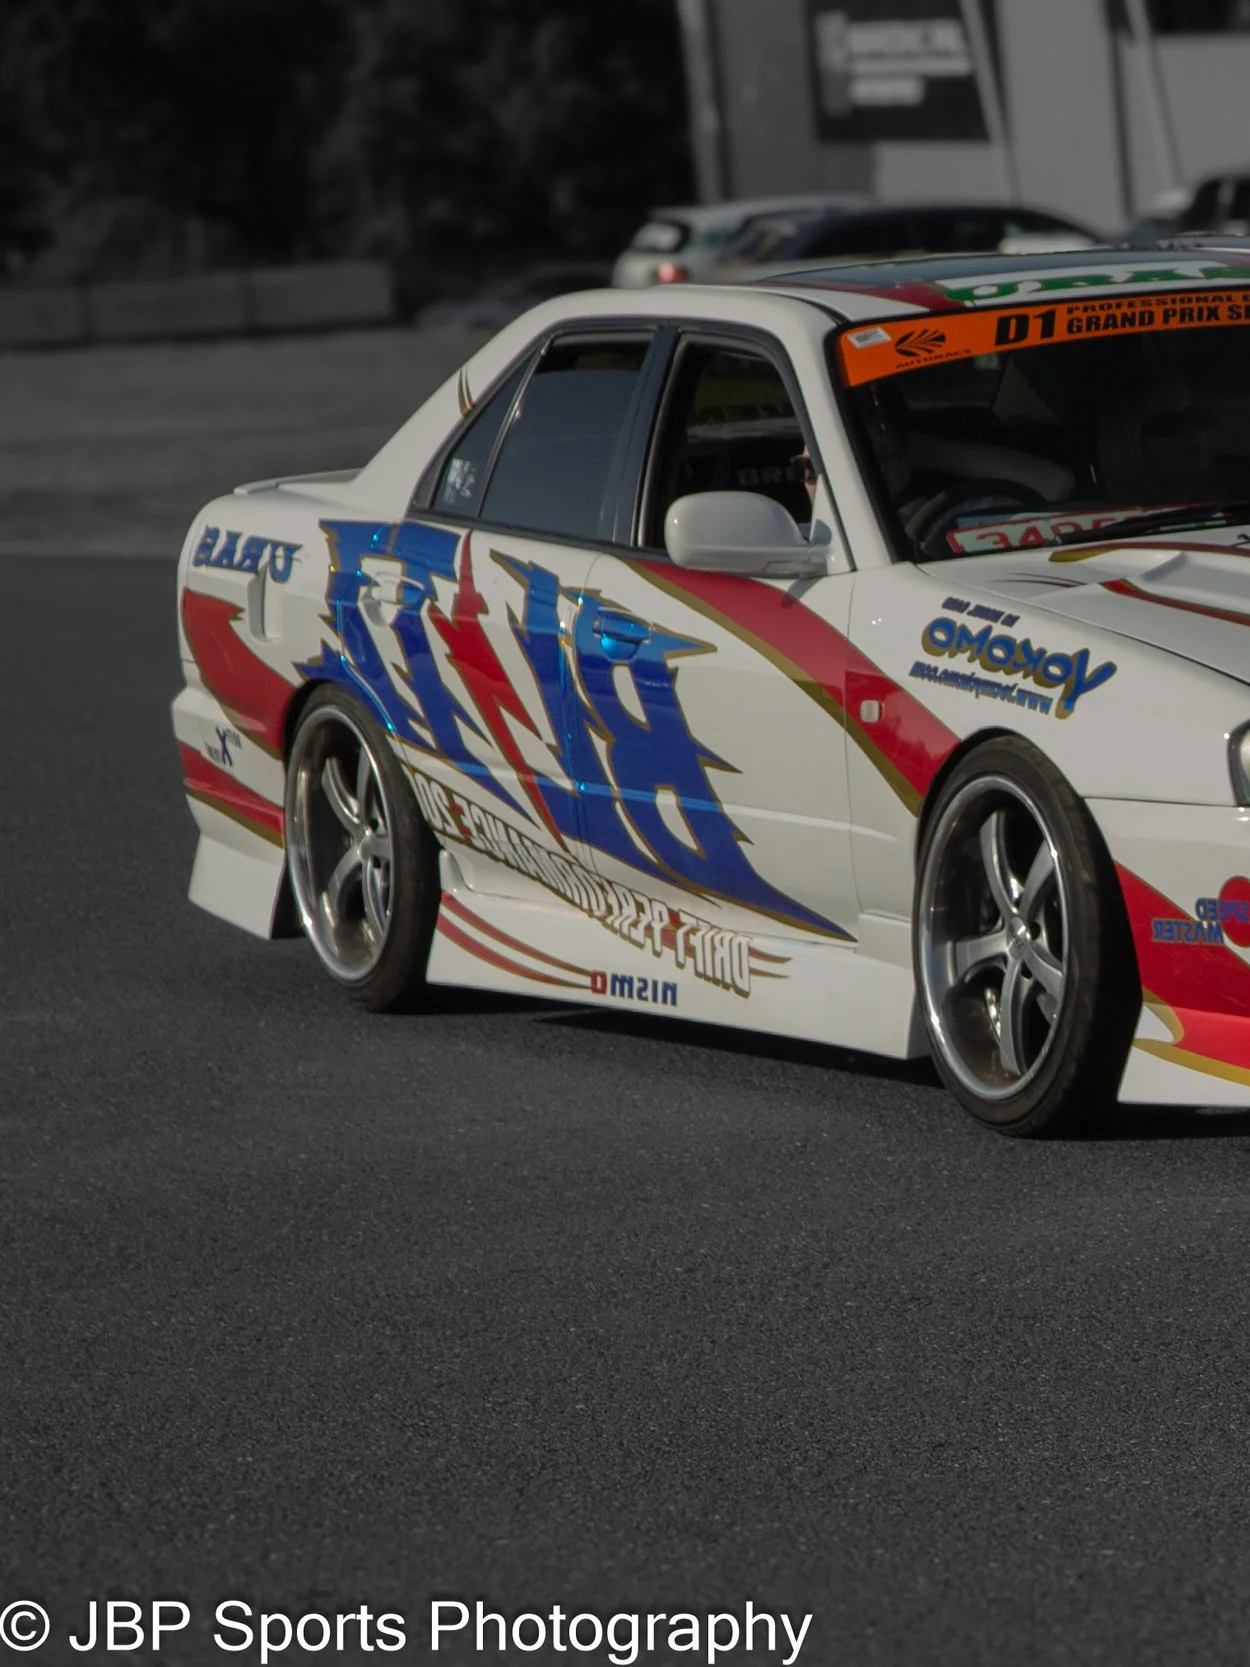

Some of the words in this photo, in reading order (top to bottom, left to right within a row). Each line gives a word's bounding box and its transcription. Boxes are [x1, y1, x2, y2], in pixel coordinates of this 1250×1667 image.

[1067, 295, 1235, 315] PROFESSIONAL
[995, 308, 1057, 347] D1
[1067, 309, 1156, 335] GRAND
[1163, 304, 1221, 325] PRIX
